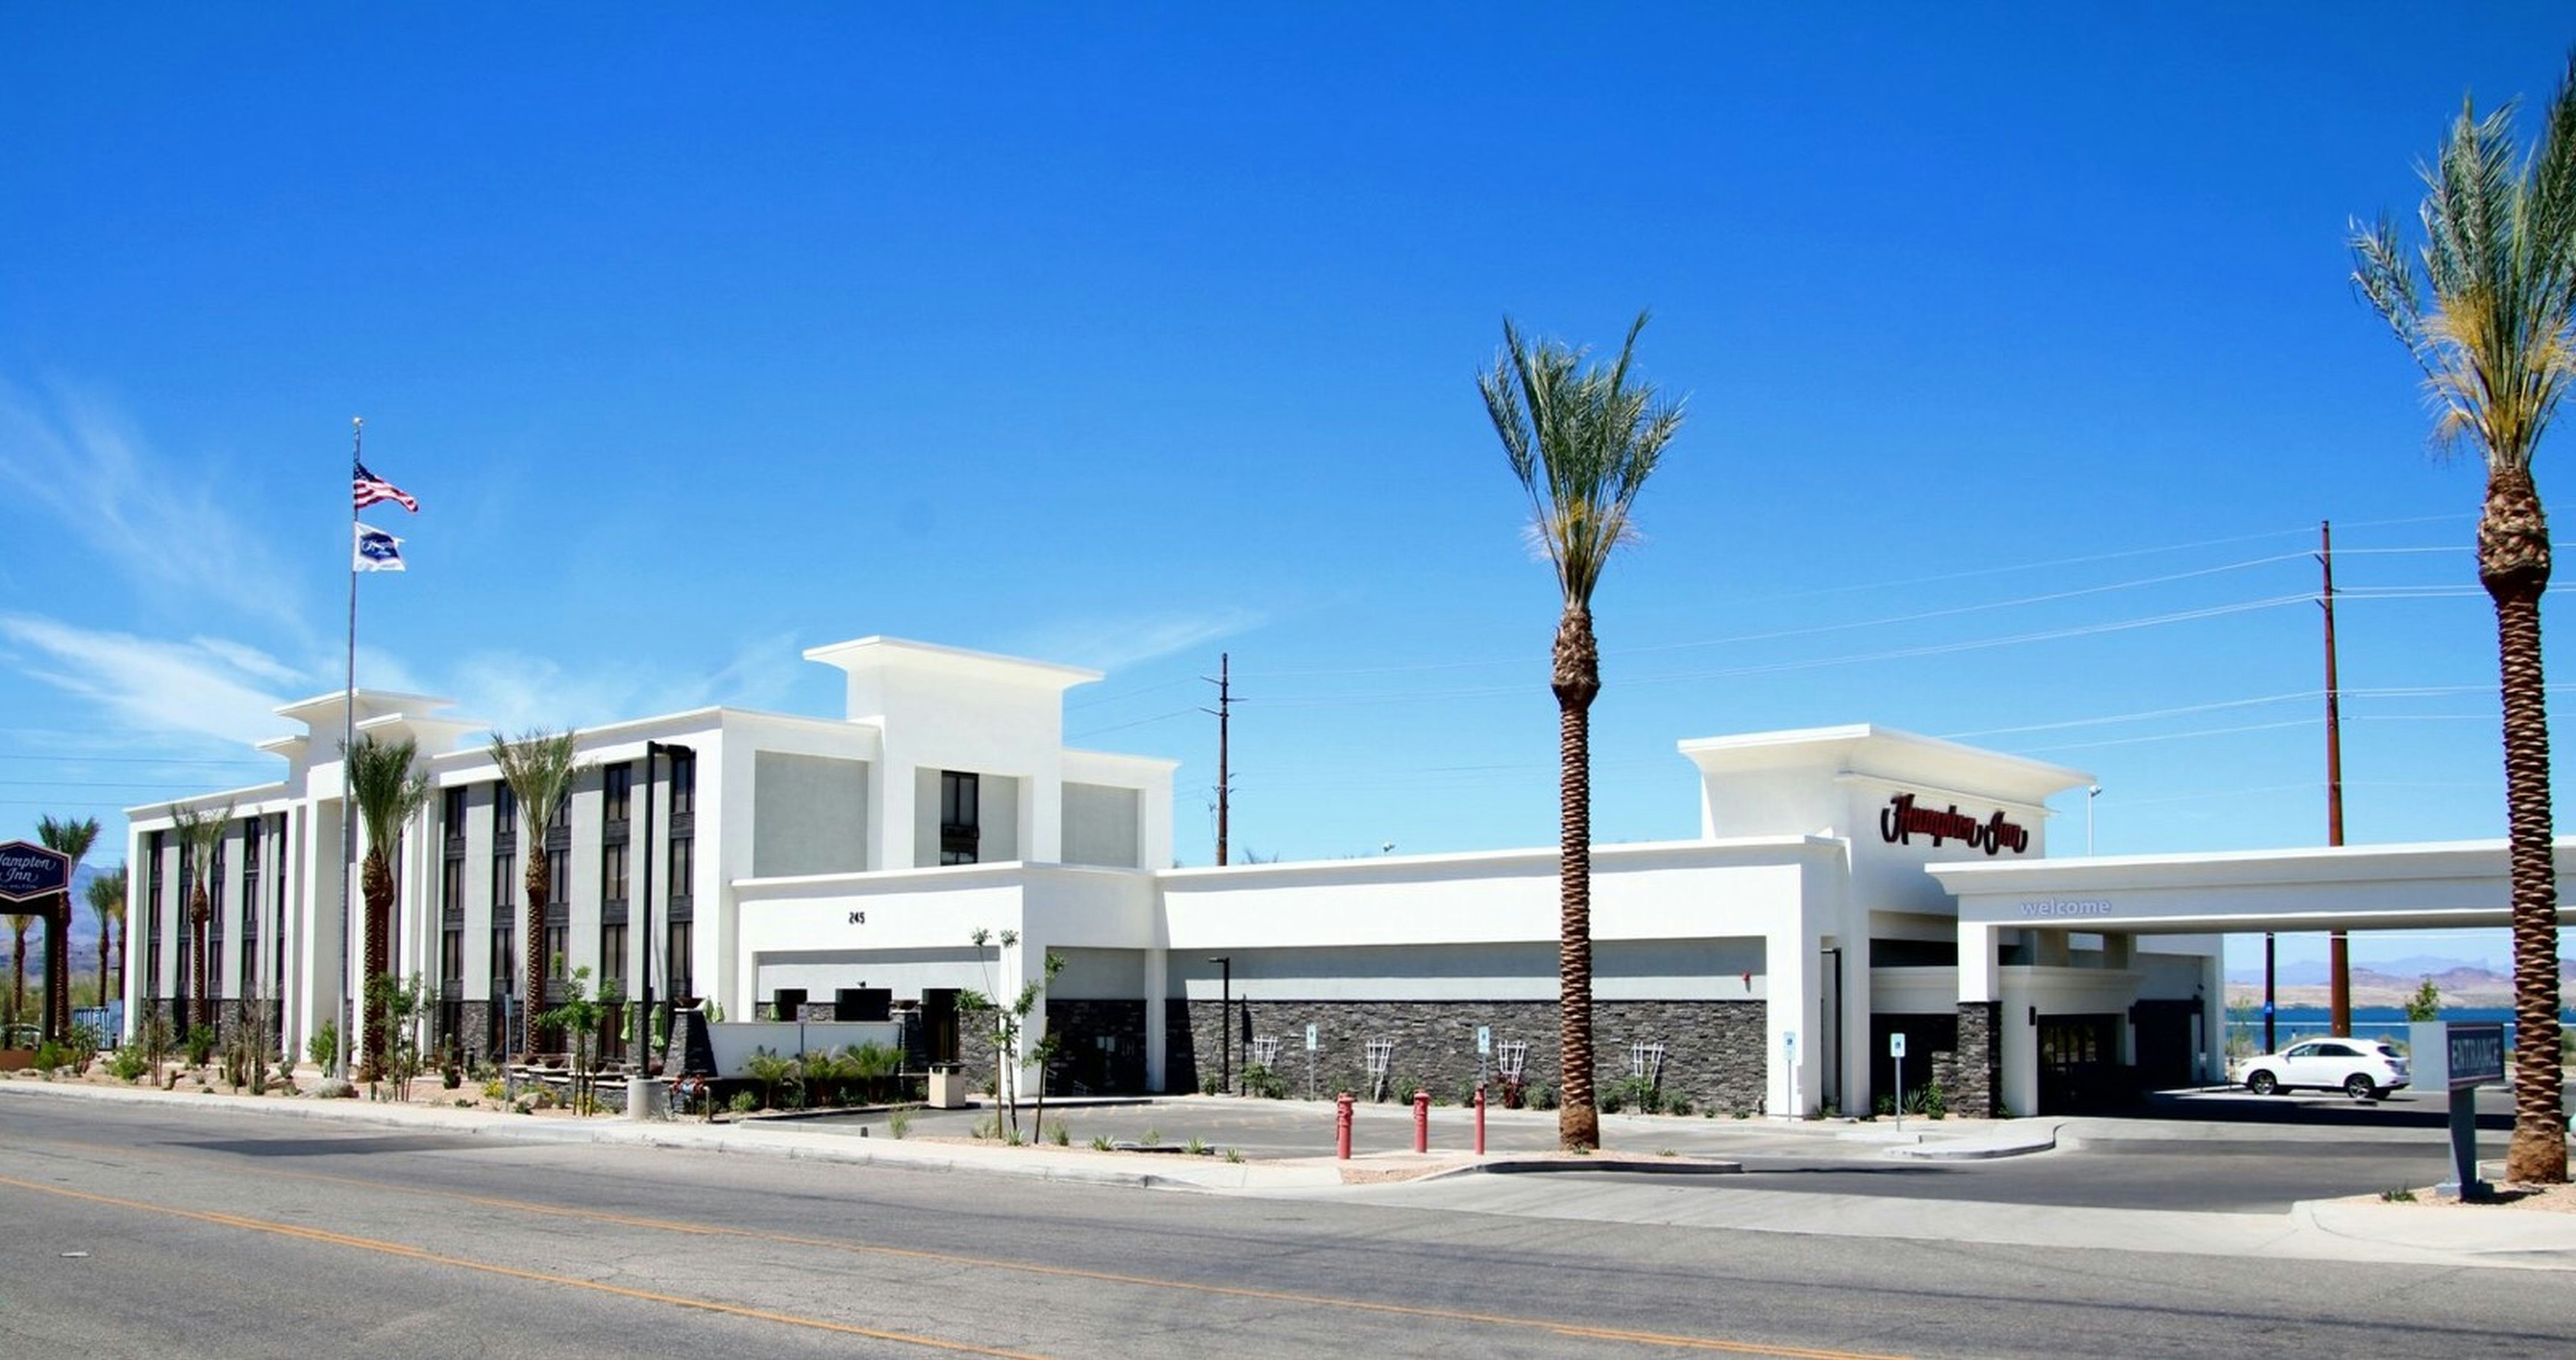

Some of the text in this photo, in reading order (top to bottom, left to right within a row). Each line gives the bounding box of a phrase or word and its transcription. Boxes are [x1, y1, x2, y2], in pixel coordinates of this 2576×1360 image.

[1881, 794, 2028, 856] Hampton Inn
[0, 868, 39, 882] Inn
[2020, 898, 2112, 915] welcome
[849, 912, 865, 924] 245
[2452, 1038, 2500, 1070] ENTRANCE
